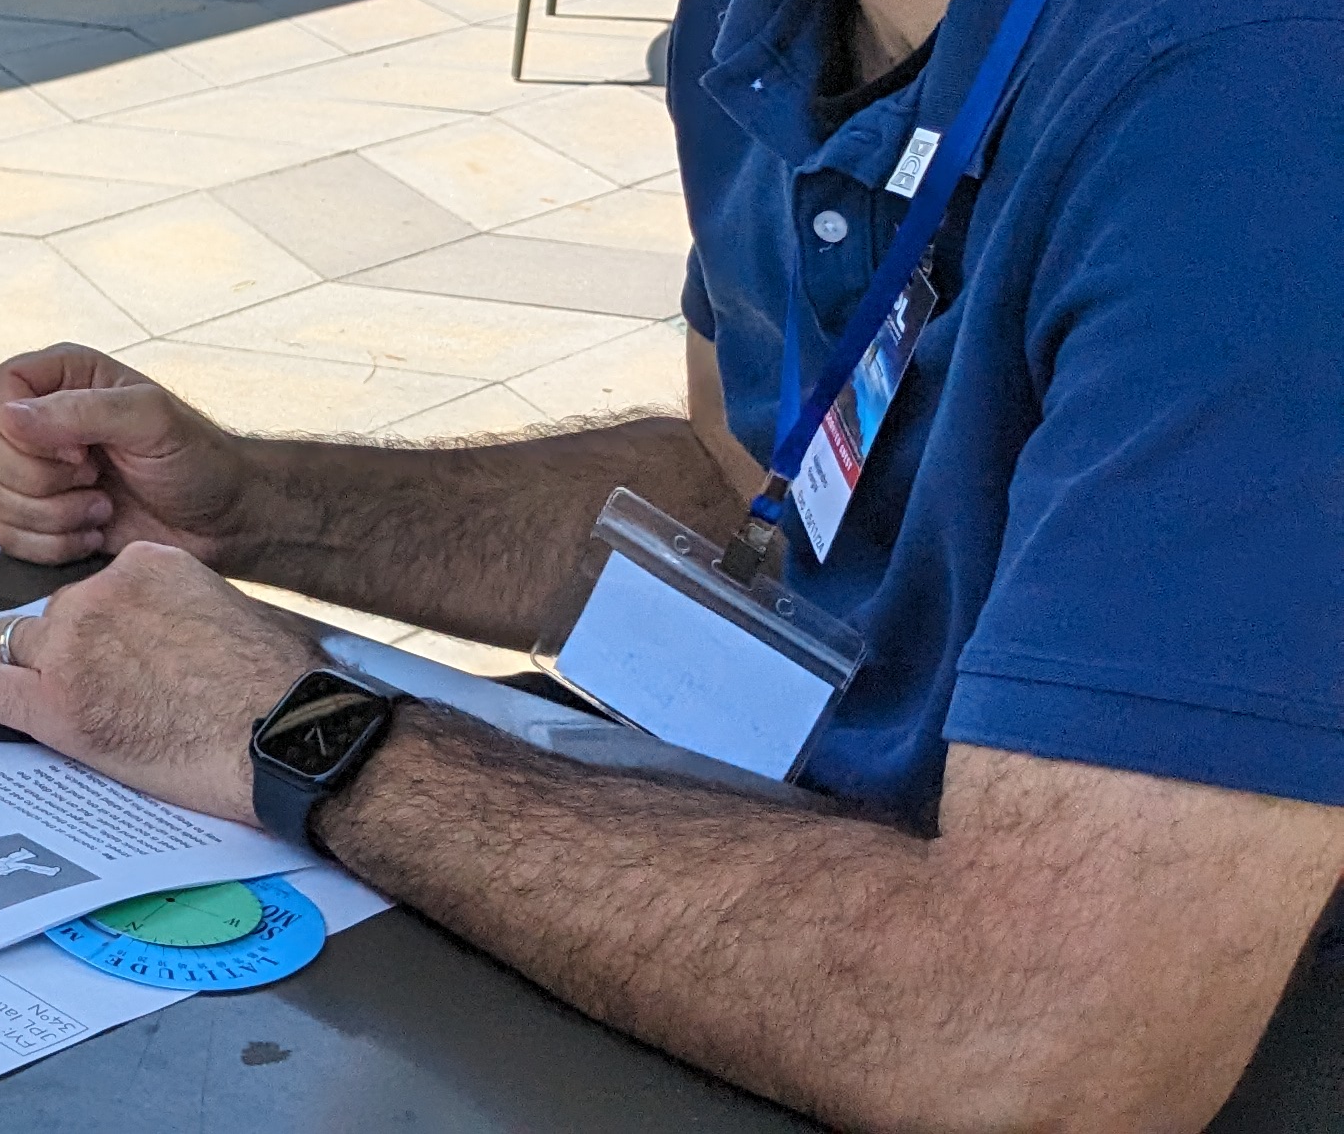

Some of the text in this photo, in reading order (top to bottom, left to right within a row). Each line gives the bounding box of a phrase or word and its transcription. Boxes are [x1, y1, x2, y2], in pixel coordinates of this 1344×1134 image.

[804, 506, 824, 554] 05/11/24
[33, 768, 54, 781] table
[48, 764, 60, 772] He
[16, 771, 31, 780] the
[85, 772, 107, 787] table
[53, 781, 68, 790] the
[50, 791, 66, 801] hot
[65, 789, 85, 799] and
[105, 787, 133, 802] picnic
[32, 805, 54, 815] park
[44, 800, 68, 813] some
[98, 797, 124, 810] salad
[65, 812, 83, 820] get
[172, 814, 193, 827] keep
[78, 820, 98, 829] and
[155, 817, 182, 831] shade
[76, 828, 104, 843] comes
[117, 830, 137, 839] and
[181, 831, 207, 845] needs
[64, 833, 97, 850] teacher
[136, 839, 164, 852] peace
[122, 920, 143, 932] N
[222, 916, 240, 928] W
[58, 926, 84, 941] M
[104, 953, 279, 981] LATITUDE
[23, 1018, 56, 1041] JPL
[1, 1027, 36, 1048] FYI:
